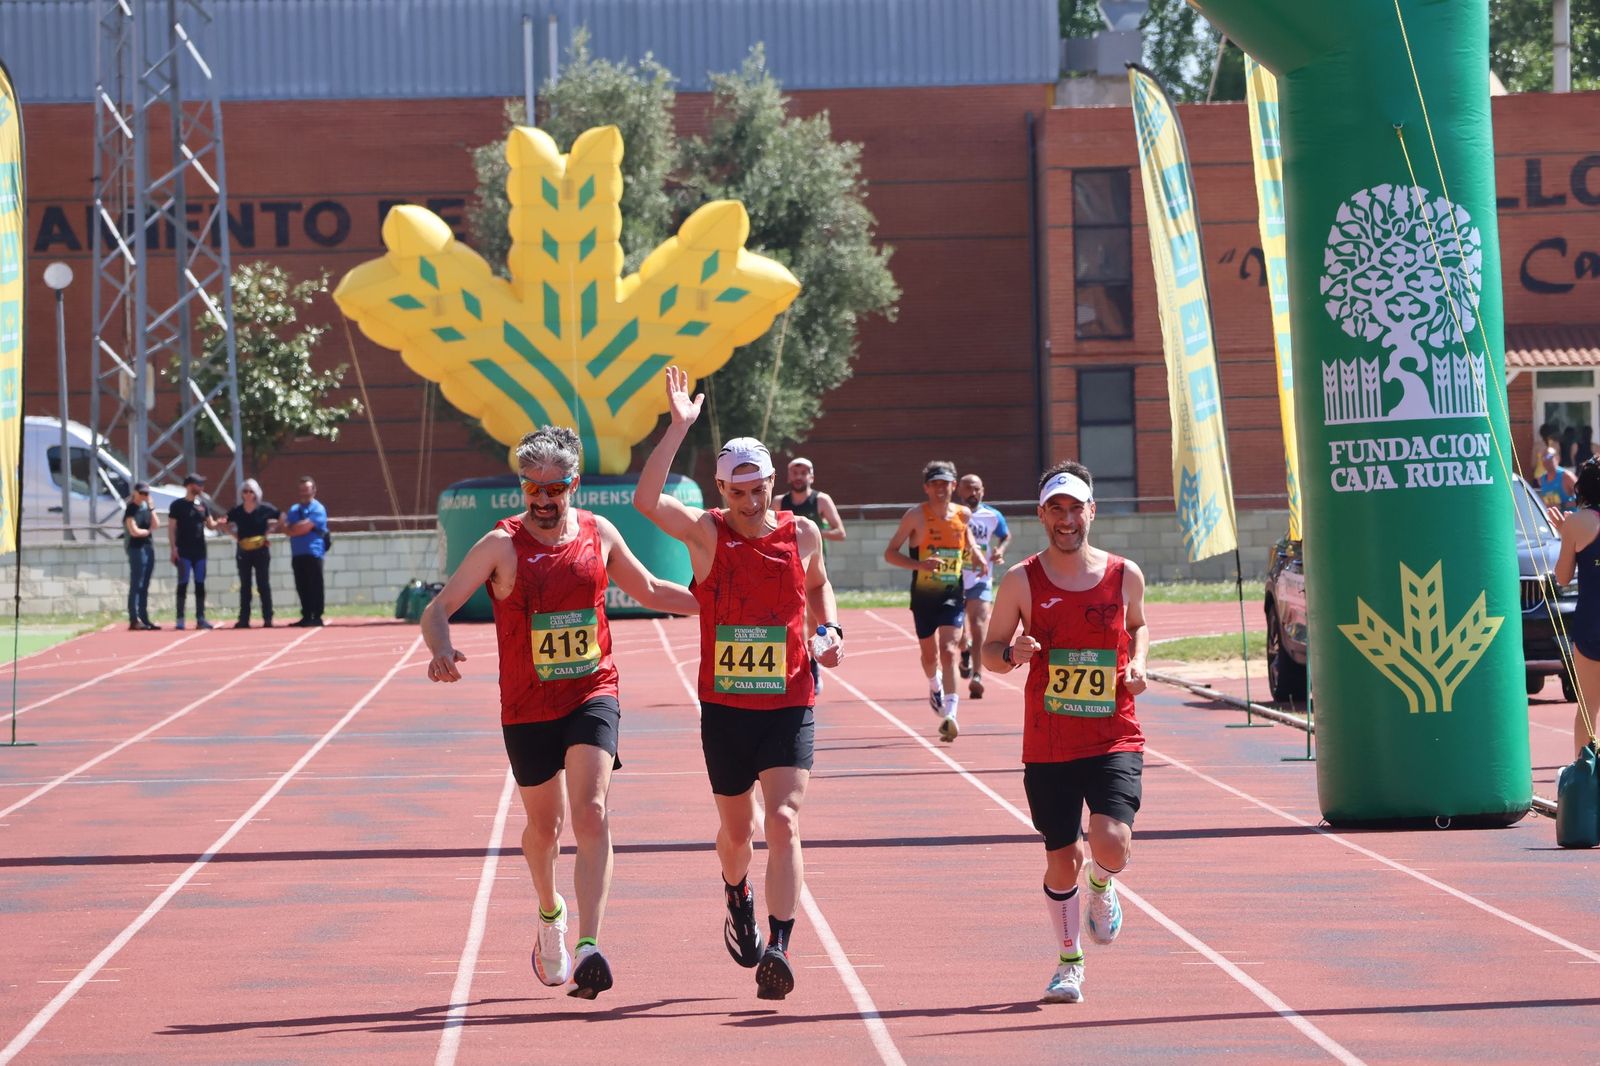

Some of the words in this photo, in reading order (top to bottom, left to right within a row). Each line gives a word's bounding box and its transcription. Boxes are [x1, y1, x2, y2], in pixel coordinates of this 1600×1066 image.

[1328, 433, 1491, 465] FUNDACION
[1330, 465, 1399, 493] CAJA
[1404, 460, 1494, 488] RURAL
[539, 629, 588, 659] 413
[554, 667, 575, 675] CAJA
[719, 645, 776, 672] 444
[734, 681, 754, 689] CAJA
[755, 681, 782, 689] RURAL
[1053, 668, 1105, 696] 379
[1063, 703, 1083, 712] CAJA
[1085, 705, 1112, 713] RURAL
